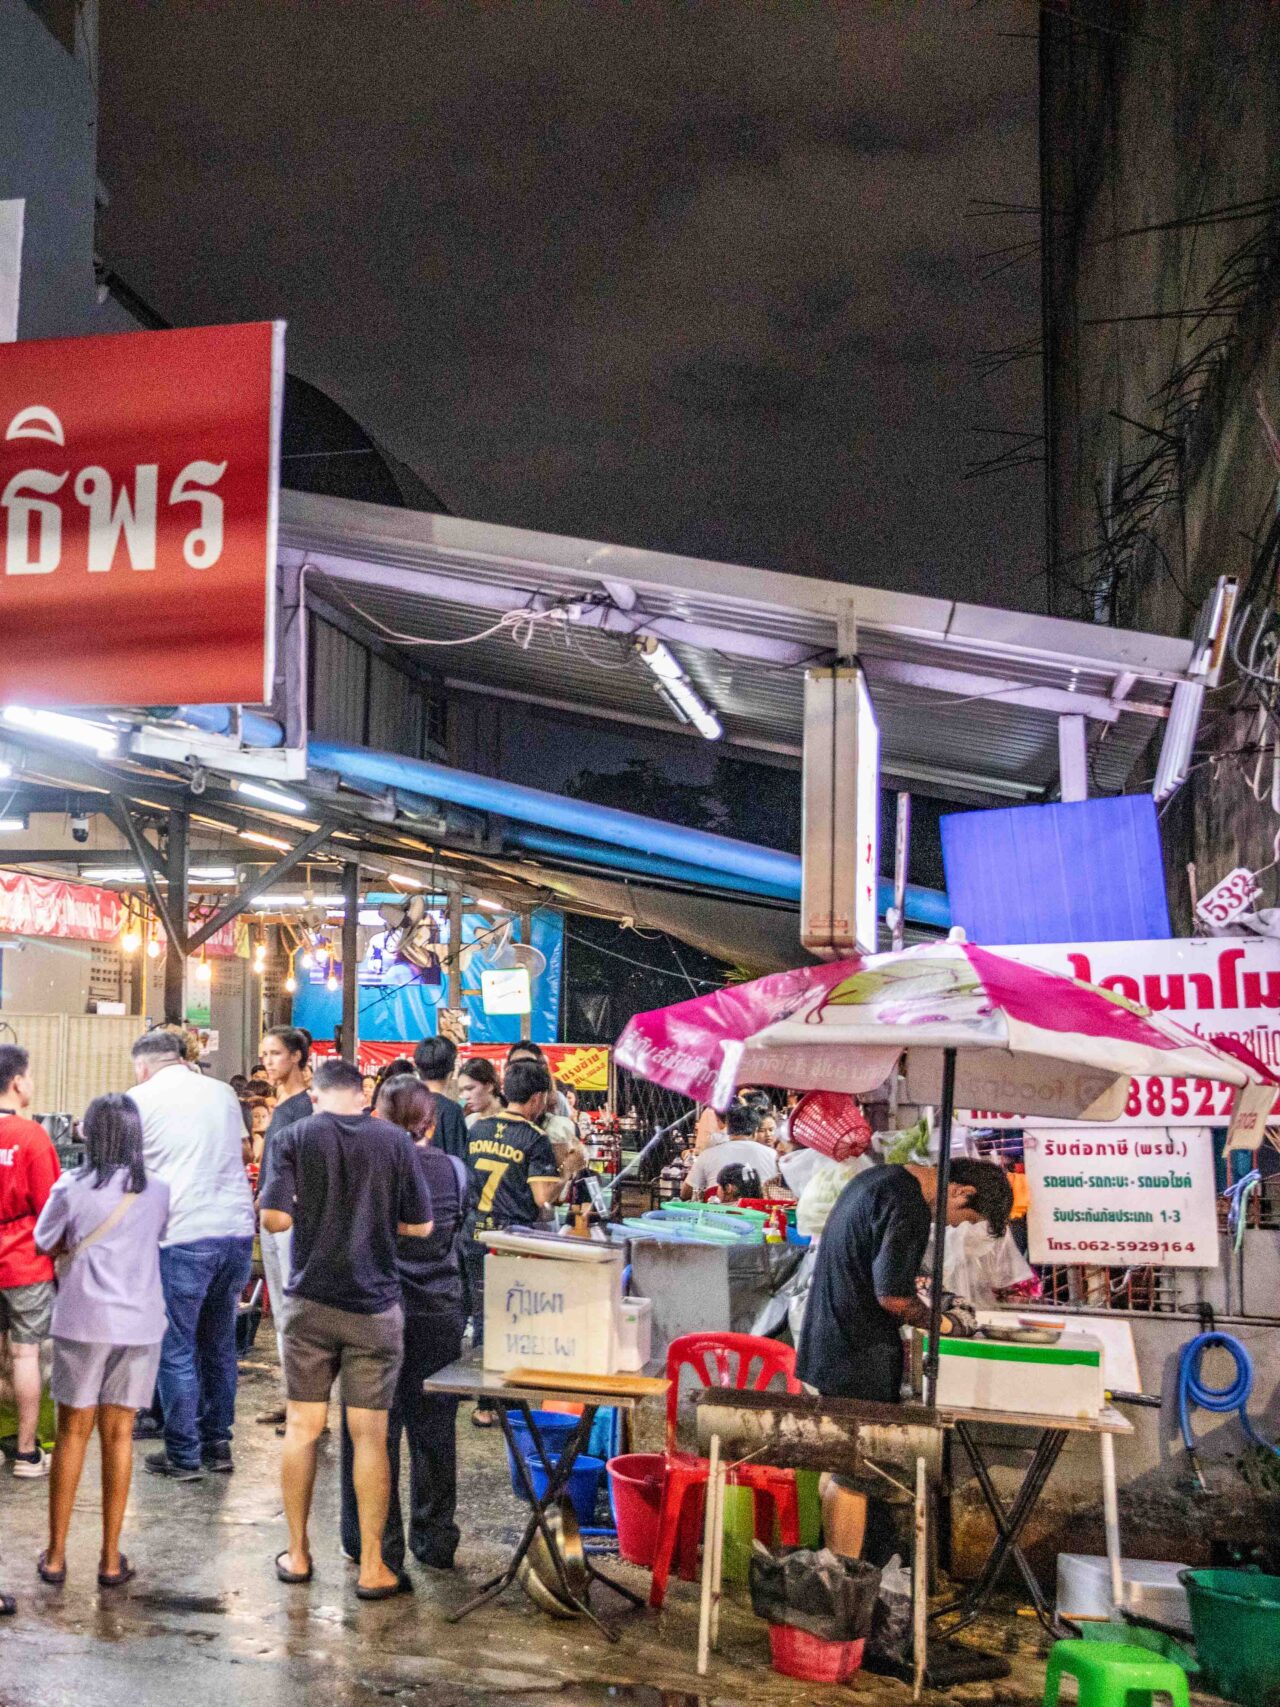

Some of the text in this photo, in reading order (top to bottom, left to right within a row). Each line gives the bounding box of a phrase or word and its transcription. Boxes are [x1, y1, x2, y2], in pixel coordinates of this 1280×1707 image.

[468, 1139, 525, 1164] RONALDO
[1045, 1139, 1128, 1157] รับต่อภาษี
[474, 1157, 510, 1213] 7
[1160, 1210, 1181, 1223] 1-3
